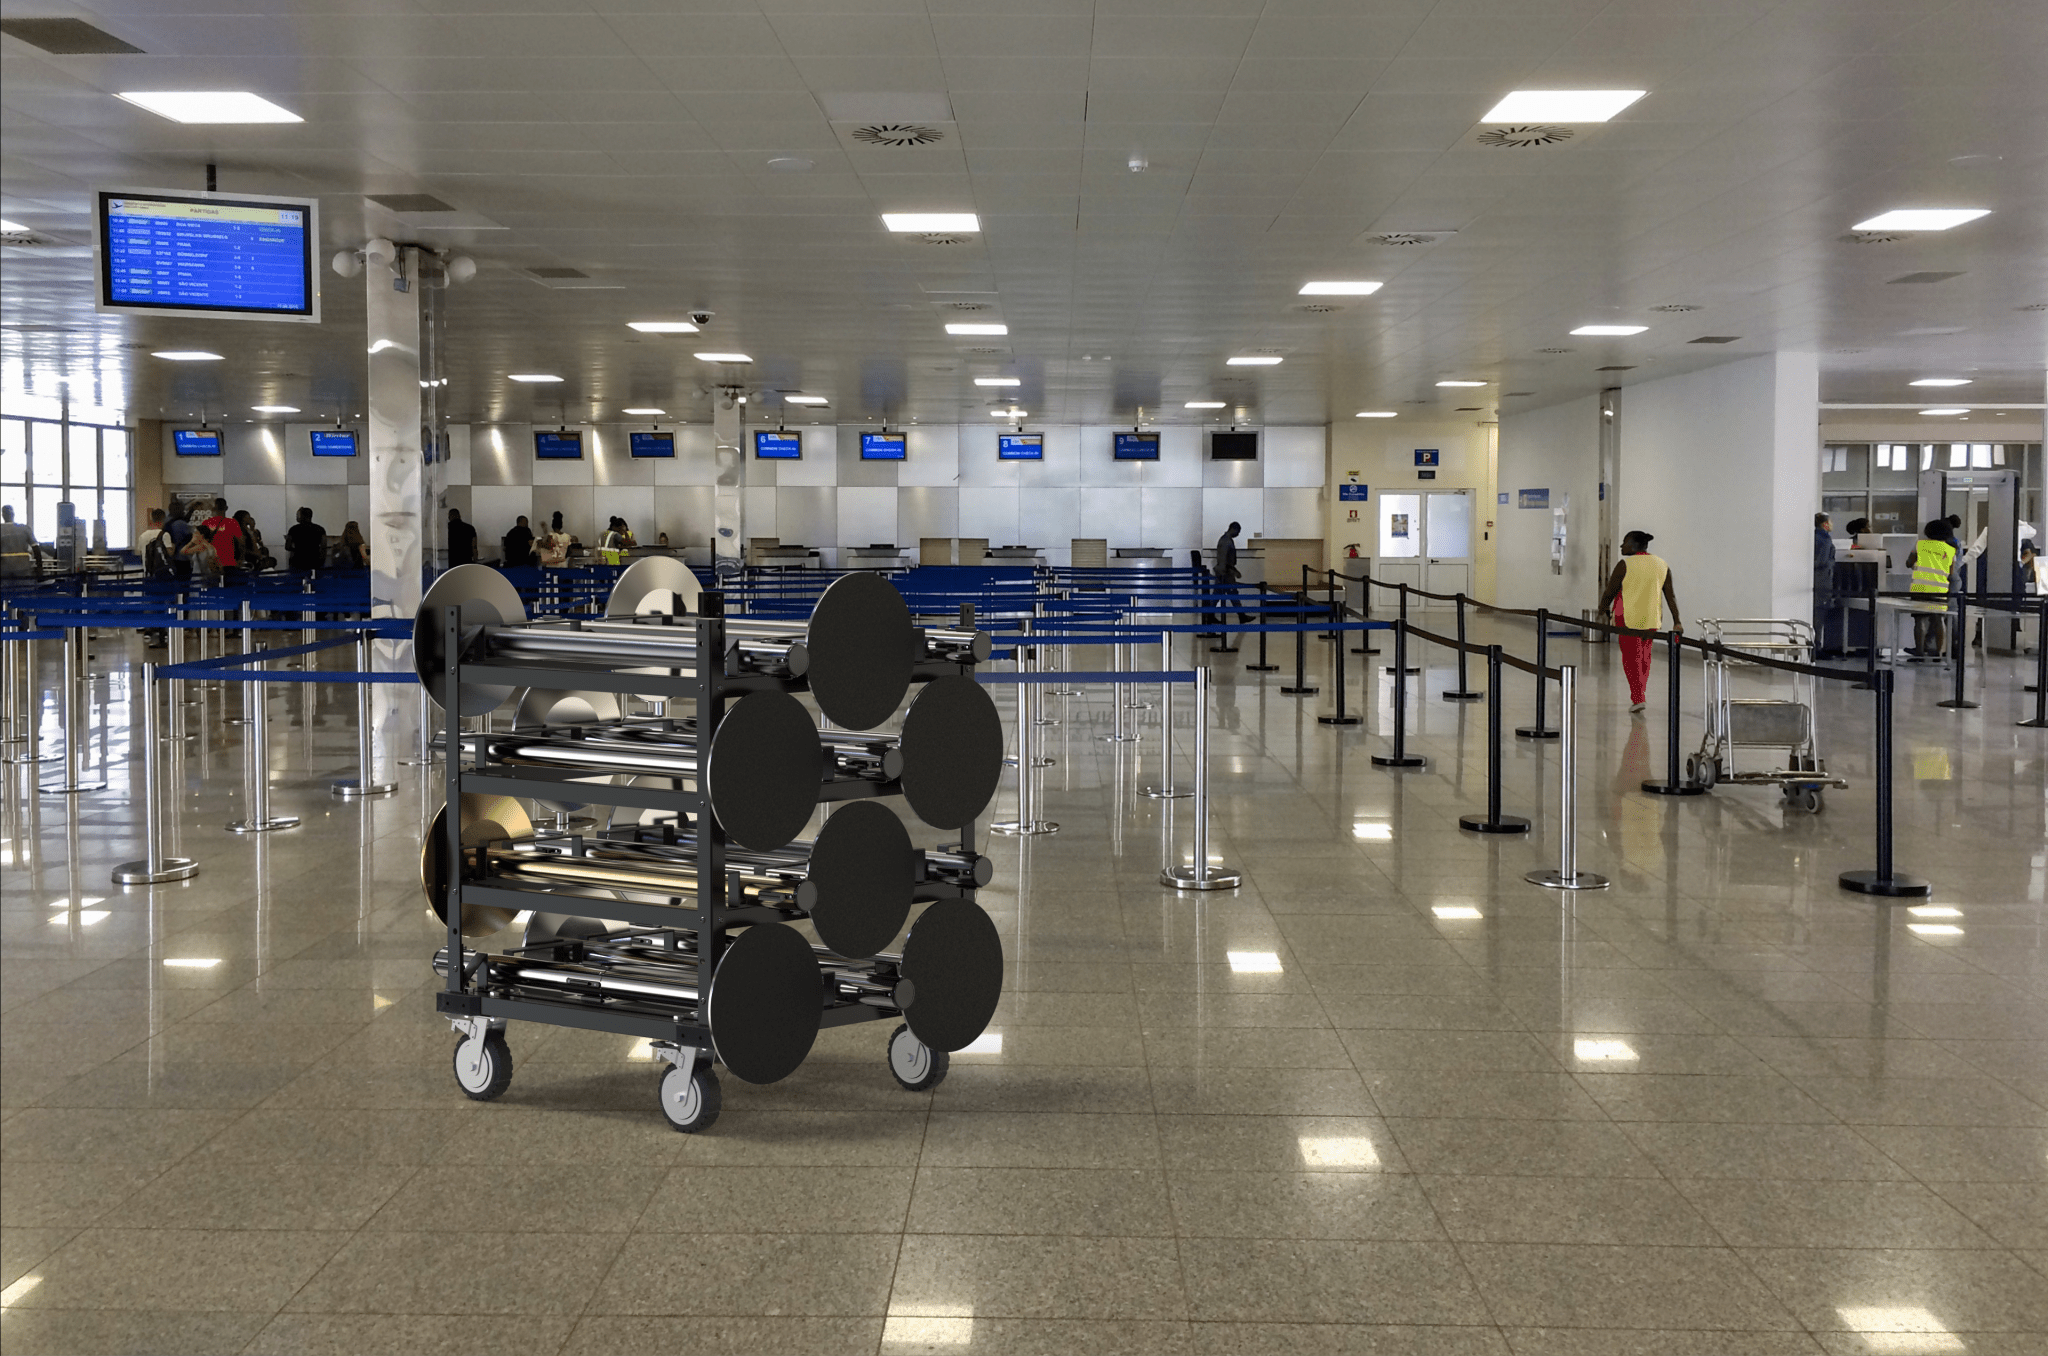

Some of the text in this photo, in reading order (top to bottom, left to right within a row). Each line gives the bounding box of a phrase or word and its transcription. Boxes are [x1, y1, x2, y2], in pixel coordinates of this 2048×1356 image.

[315, 433, 321, 441] 2
[760, 435, 766, 443] 6
[864, 436, 871, 444] 7
[1002, 440, 1008, 448] 8
[1423, 453, 1431, 463] P
